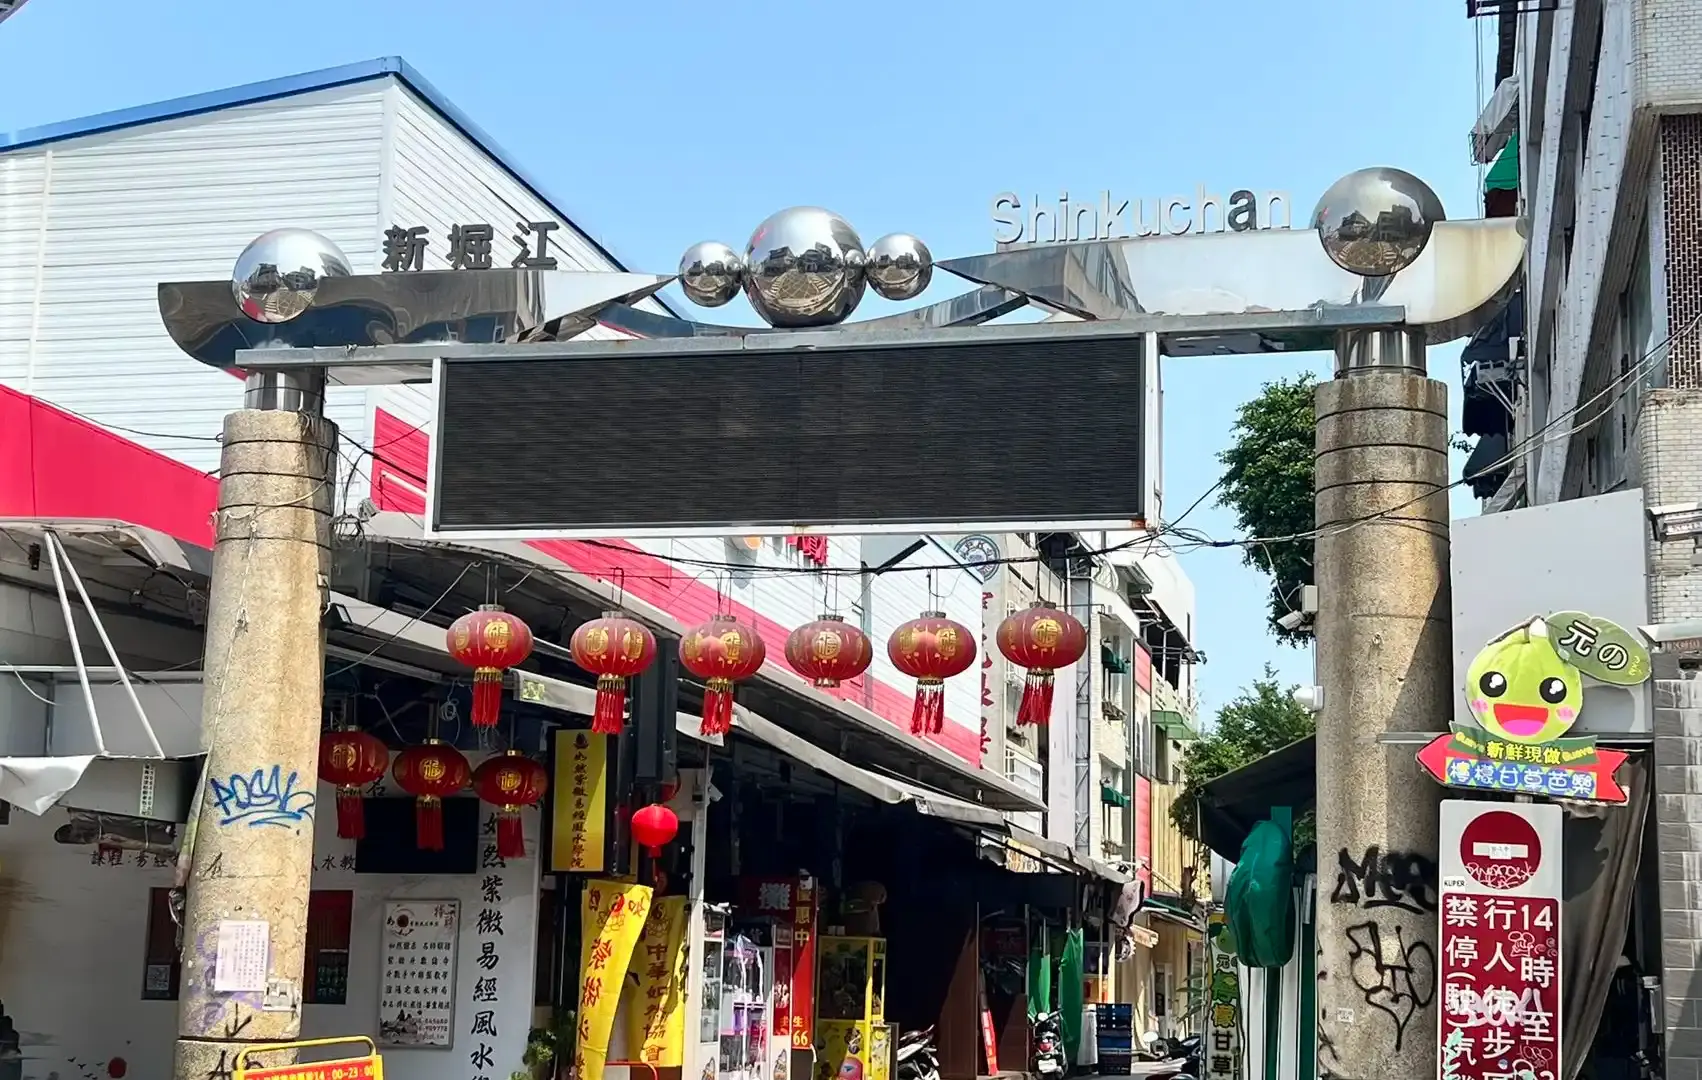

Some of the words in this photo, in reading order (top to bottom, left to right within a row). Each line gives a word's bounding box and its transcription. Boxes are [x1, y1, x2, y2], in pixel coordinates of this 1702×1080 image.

[990, 184, 1291, 244] Shinkuchan
[381, 221, 560, 271] 新堀江
[813, 630, 841, 658] 福
[1031, 619, 1062, 648] 福
[1559, 619, 1629, 670] 元の
[1486, 740, 1562, 765] 新鮮現做
[1449, 760, 1594, 796] 檸檬甘草芭樂
[792, 1029, 809, 1047] 66
